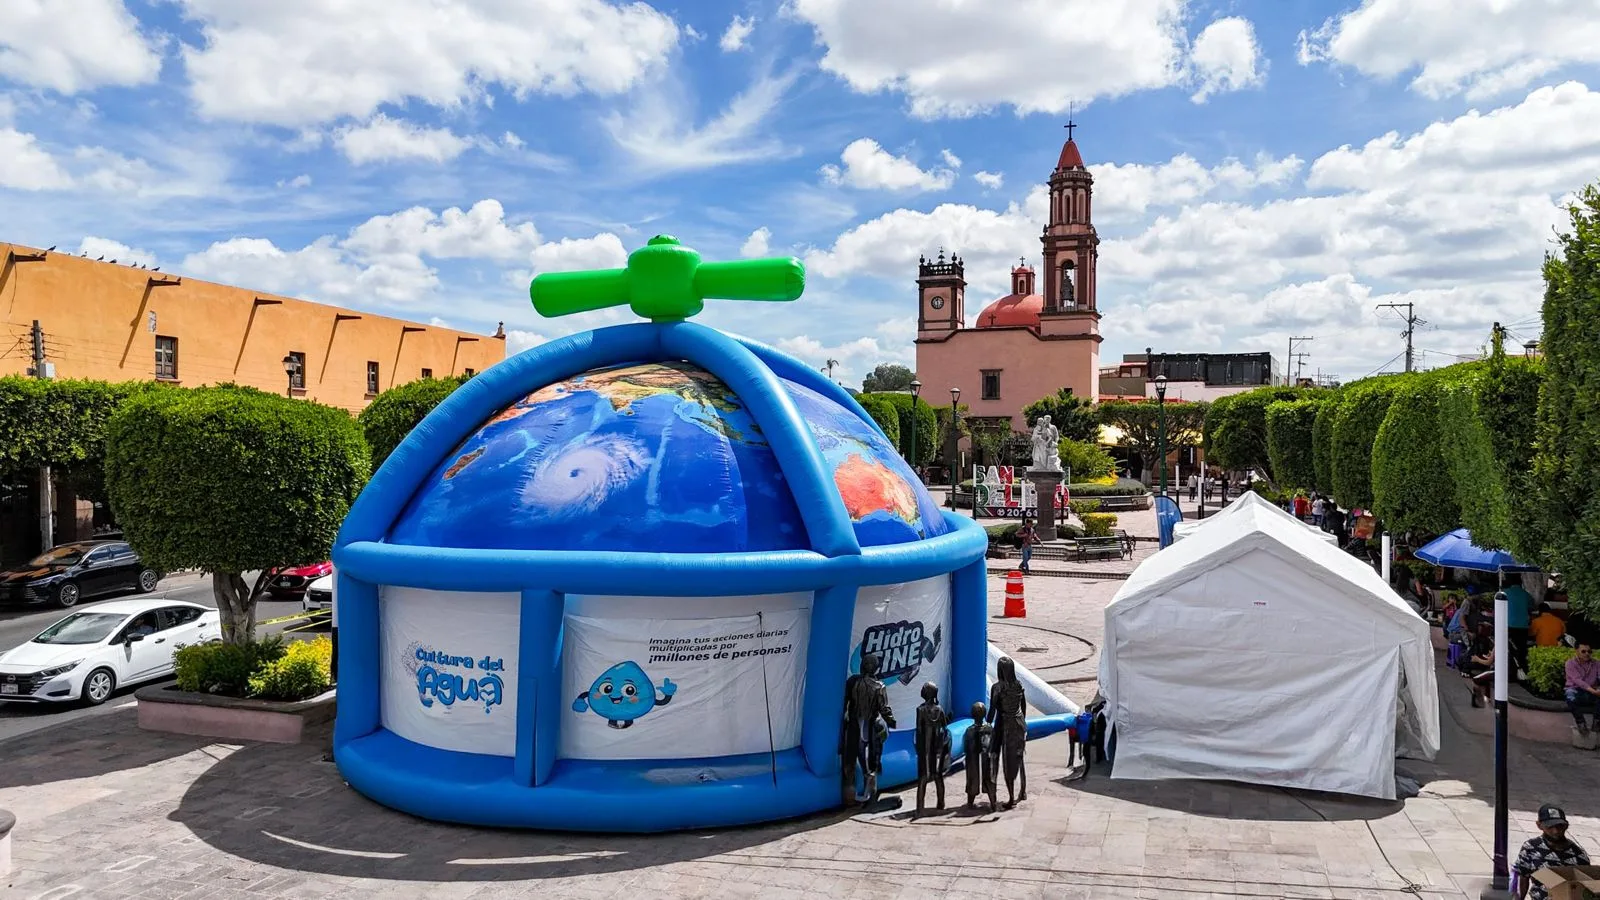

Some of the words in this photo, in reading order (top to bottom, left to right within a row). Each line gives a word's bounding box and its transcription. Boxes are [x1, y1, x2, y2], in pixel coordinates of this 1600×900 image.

[976, 465, 1014, 484] SAN
[976, 484, 1019, 508] DEL
[649, 638, 691, 646] Imagina
[713, 633, 754, 643] acciones
[757, 629, 789, 638] diarias
[649, 644, 717, 652] multiplicadas
[720, 642, 738, 651] por
[865, 626, 921, 653] Hidro
[415, 647, 474, 669] Cultura
[478, 655, 505, 671] del
[648, 652, 709, 664] ¡millones
[713, 651, 729, 660] de
[731, 644, 792, 660] personas!
[870, 641, 921, 674] INE
[417, 666, 504, 708] Agua
